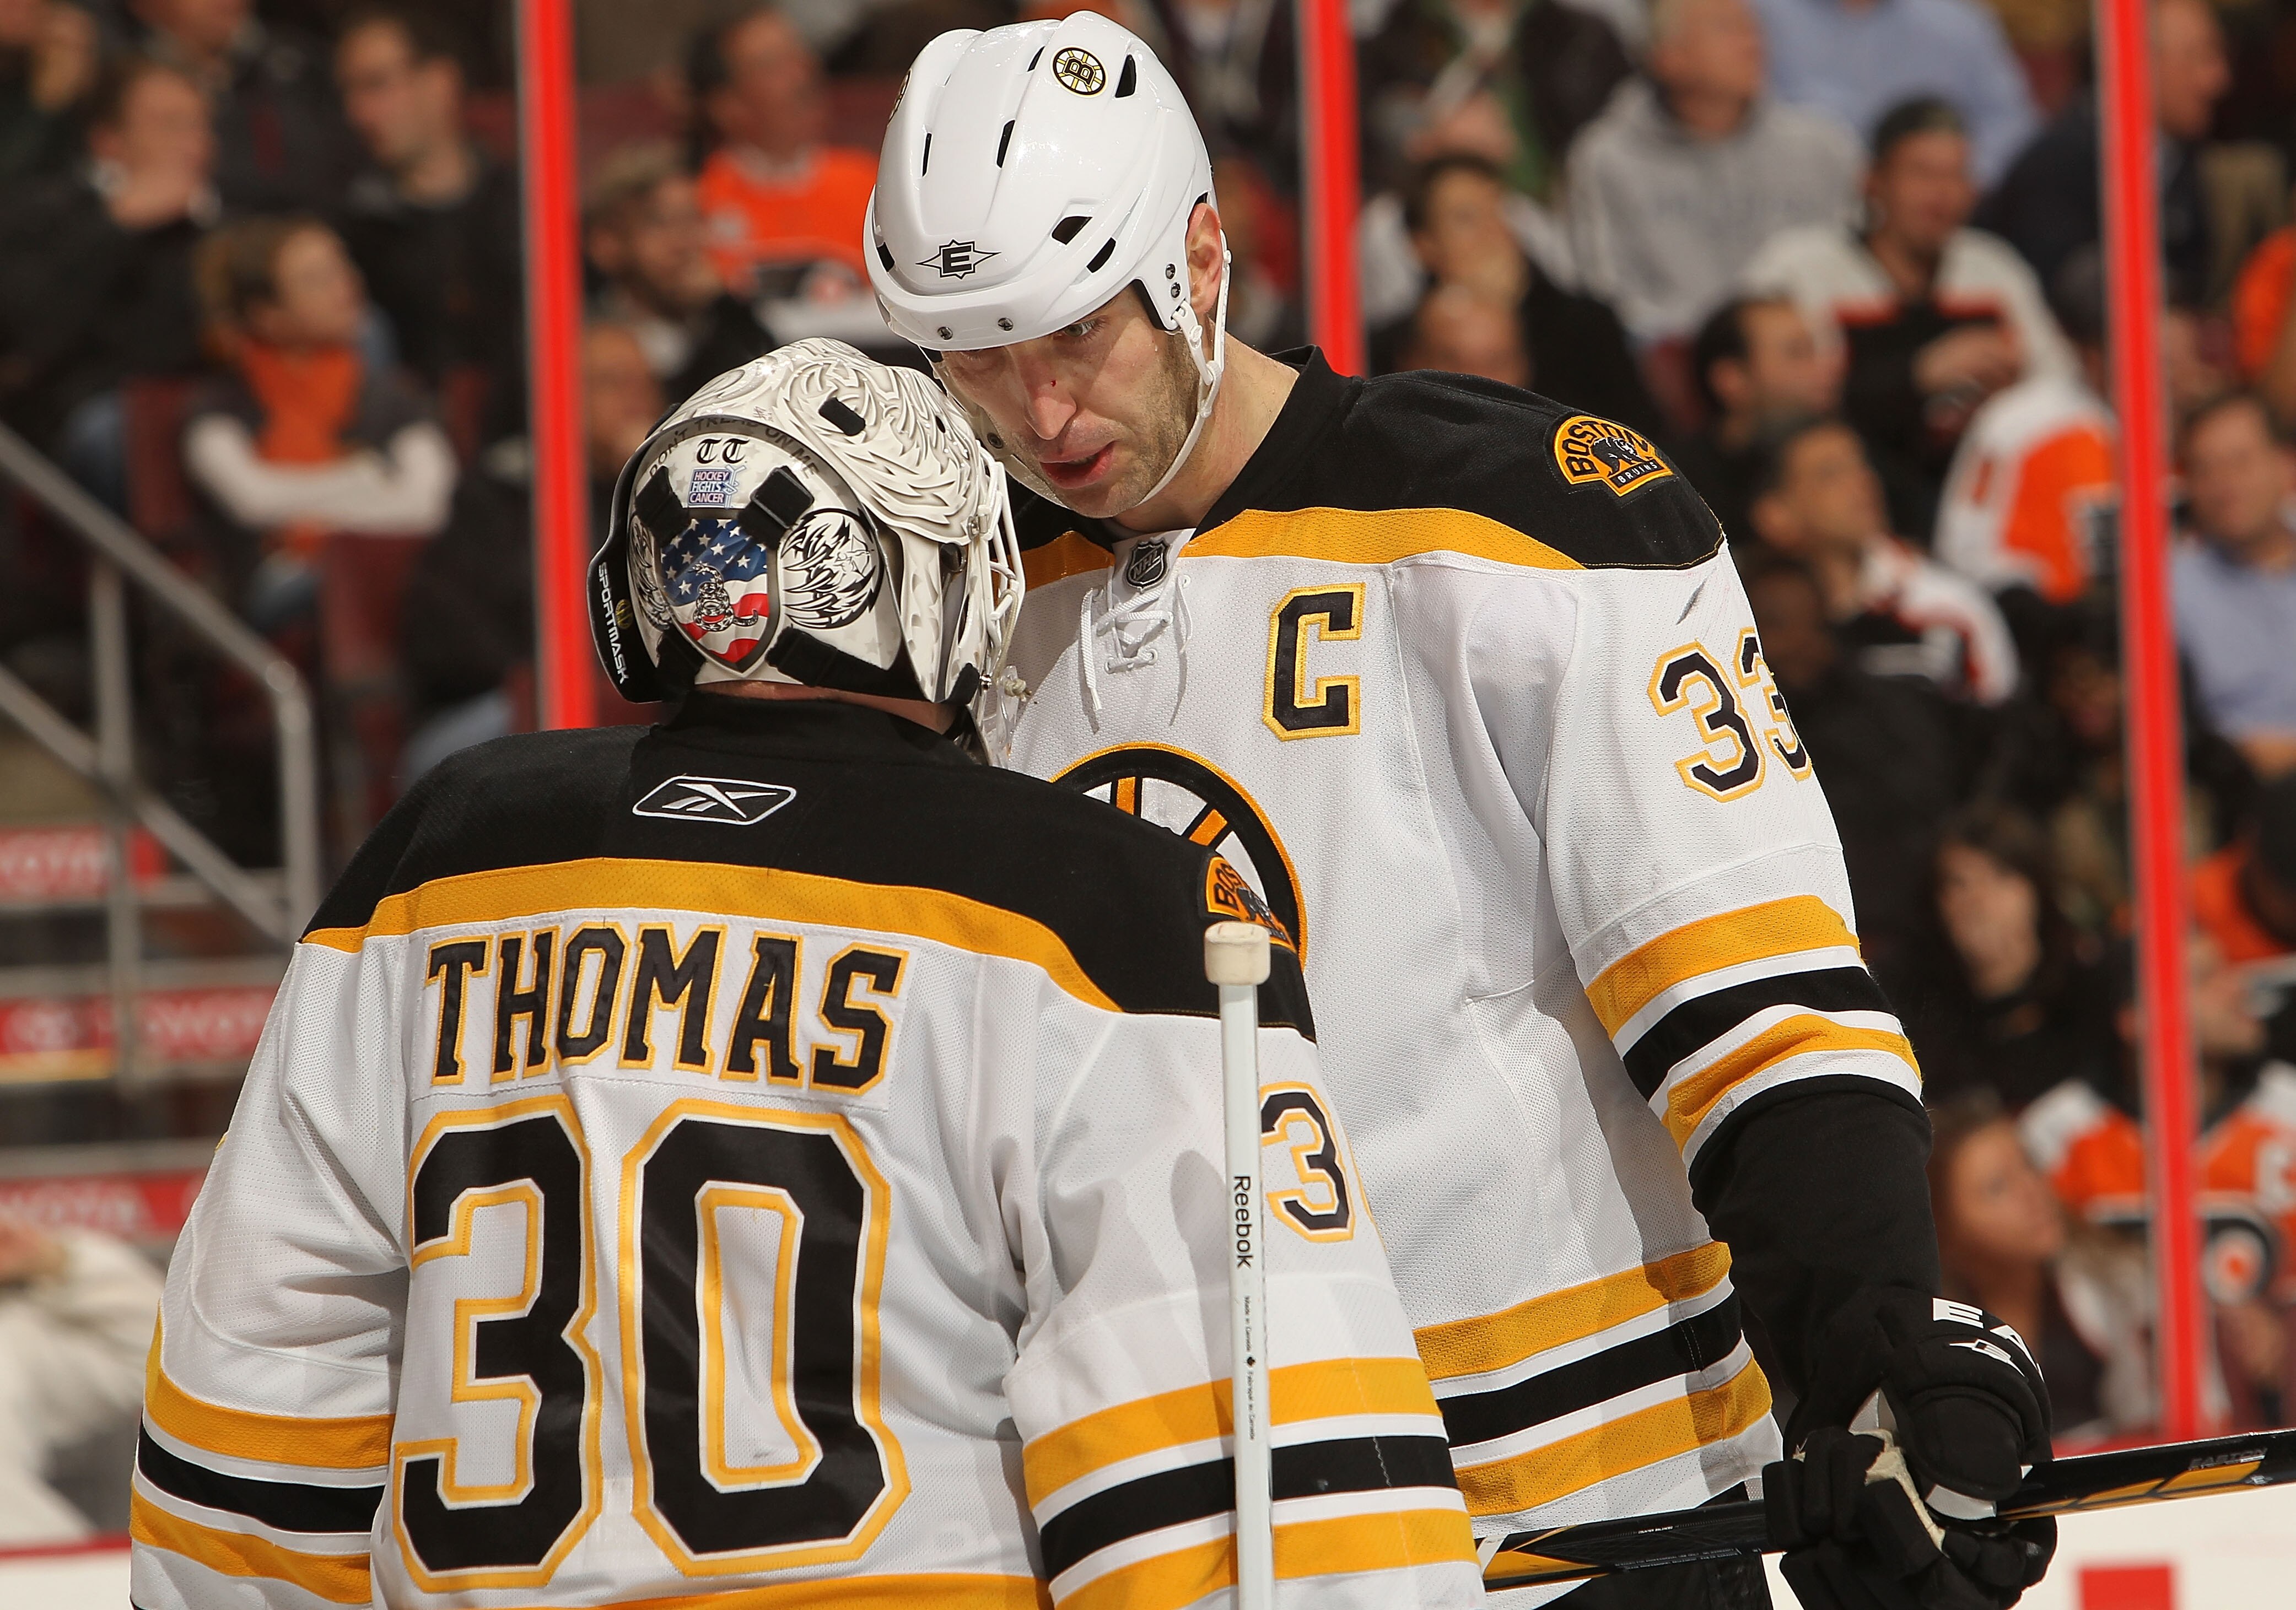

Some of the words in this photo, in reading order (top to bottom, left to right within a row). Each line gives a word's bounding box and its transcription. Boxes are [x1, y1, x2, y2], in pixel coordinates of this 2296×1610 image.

[1062, 57, 1096, 87] B
[942, 245, 972, 273] E
[791, 447, 820, 479] ME
[1562, 420, 1648, 477] BOSTON
[691, 481, 723, 492] FIGHTS
[694, 471, 730, 482] HOCKEY
[1618, 462, 1658, 483] BRUINS
[689, 493, 724, 504] CANCER
[1133, 550, 1161, 580] NHL
[599, 561, 629, 684] SPORTMASK
[1262, 582, 1365, 741] C
[1647, 626, 1812, 803] 33
[424, 921, 909, 1095] THOMAS
[1259, 1081, 1372, 1244] 3
[1234, 1176, 1254, 1268] Reebok
[392, 1094, 911, 1593] 30
